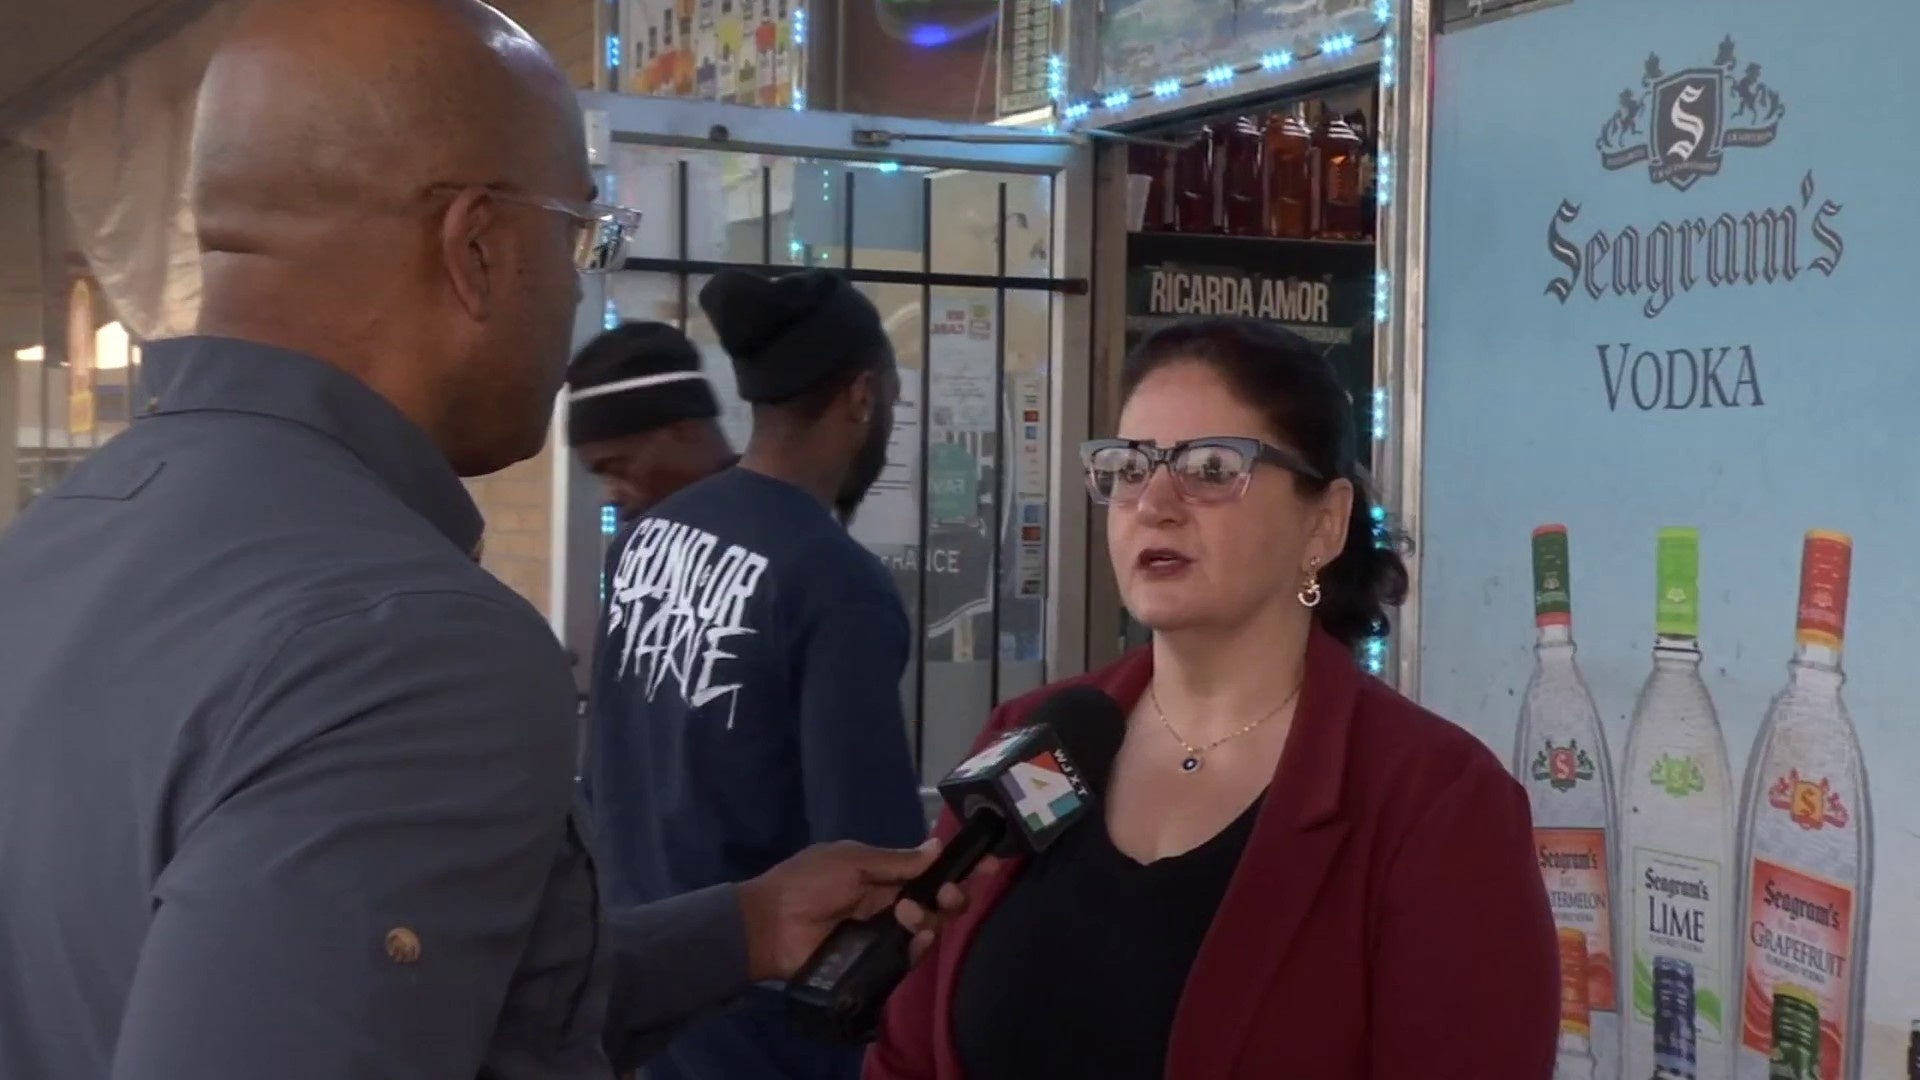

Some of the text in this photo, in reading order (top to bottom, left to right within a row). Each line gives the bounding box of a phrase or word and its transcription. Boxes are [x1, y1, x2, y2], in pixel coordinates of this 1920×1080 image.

[1543, 168, 1844, 319] Seagram's
[1151, 271, 1329, 323] RICARDA AMOR
[1597, 343, 1765, 411] VODKA
[698, 544, 769, 628] OR
[1645, 867, 1710, 901] Seagram's
[1763, 879, 1841, 931] Seagram's
[1648, 895, 1705, 943] LIME
[1750, 920, 1847, 979] GRAPEFRUIT
